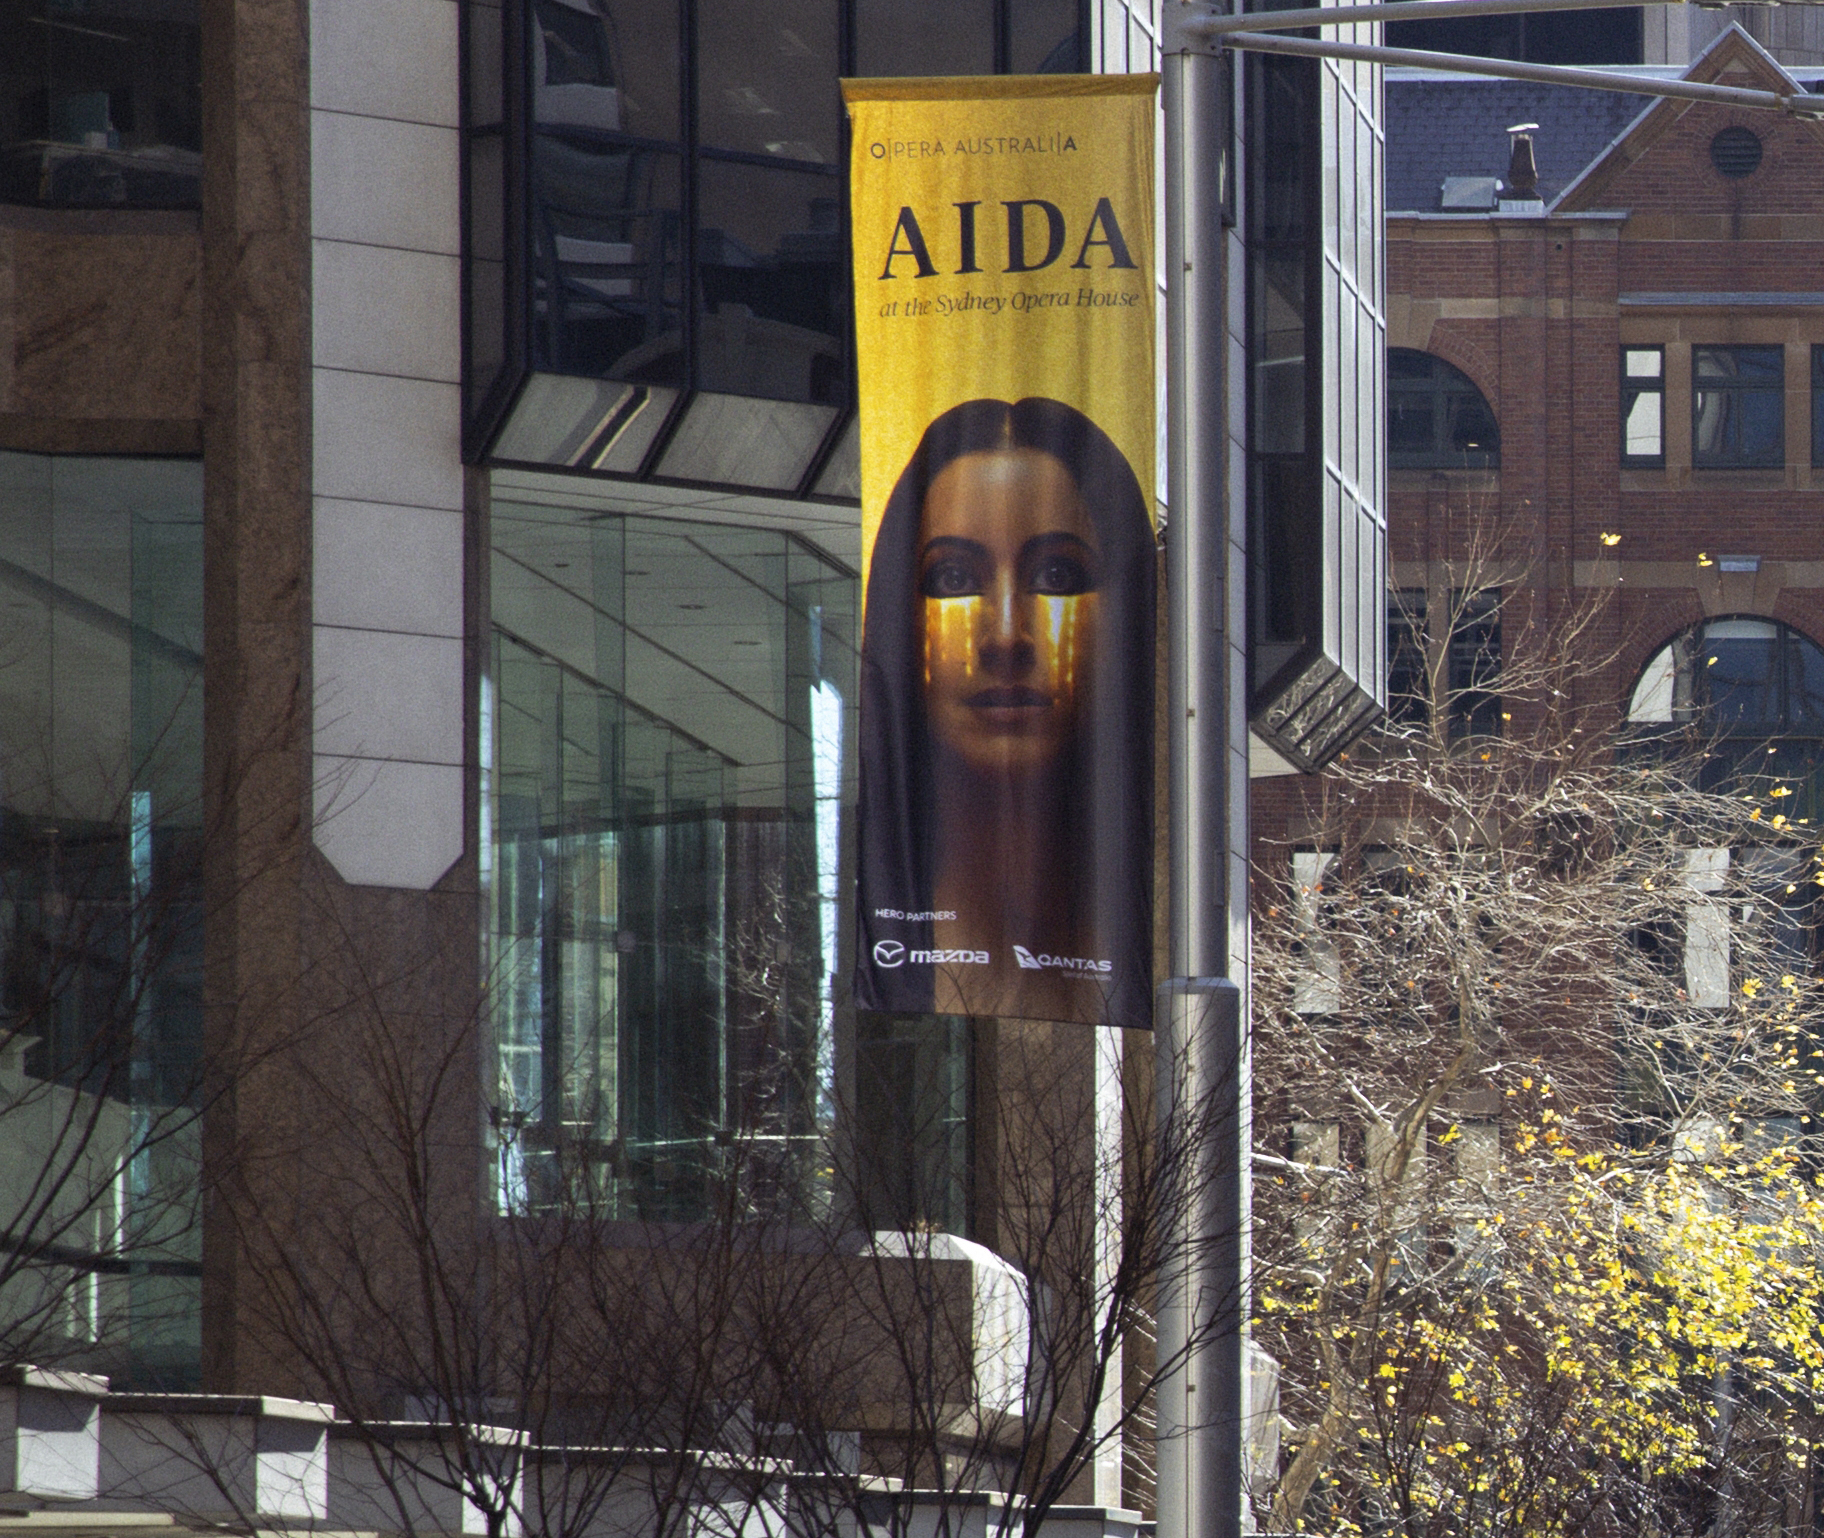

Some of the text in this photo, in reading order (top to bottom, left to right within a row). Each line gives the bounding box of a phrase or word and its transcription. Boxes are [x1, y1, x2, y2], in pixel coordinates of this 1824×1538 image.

[877, 197, 1140, 280] AIDA
[879, 287, 1140, 318] at the Sydney Opera House
[875, 908, 957, 922] HERO PARTNERS
[1037, 953, 1112, 972] QANTAS
